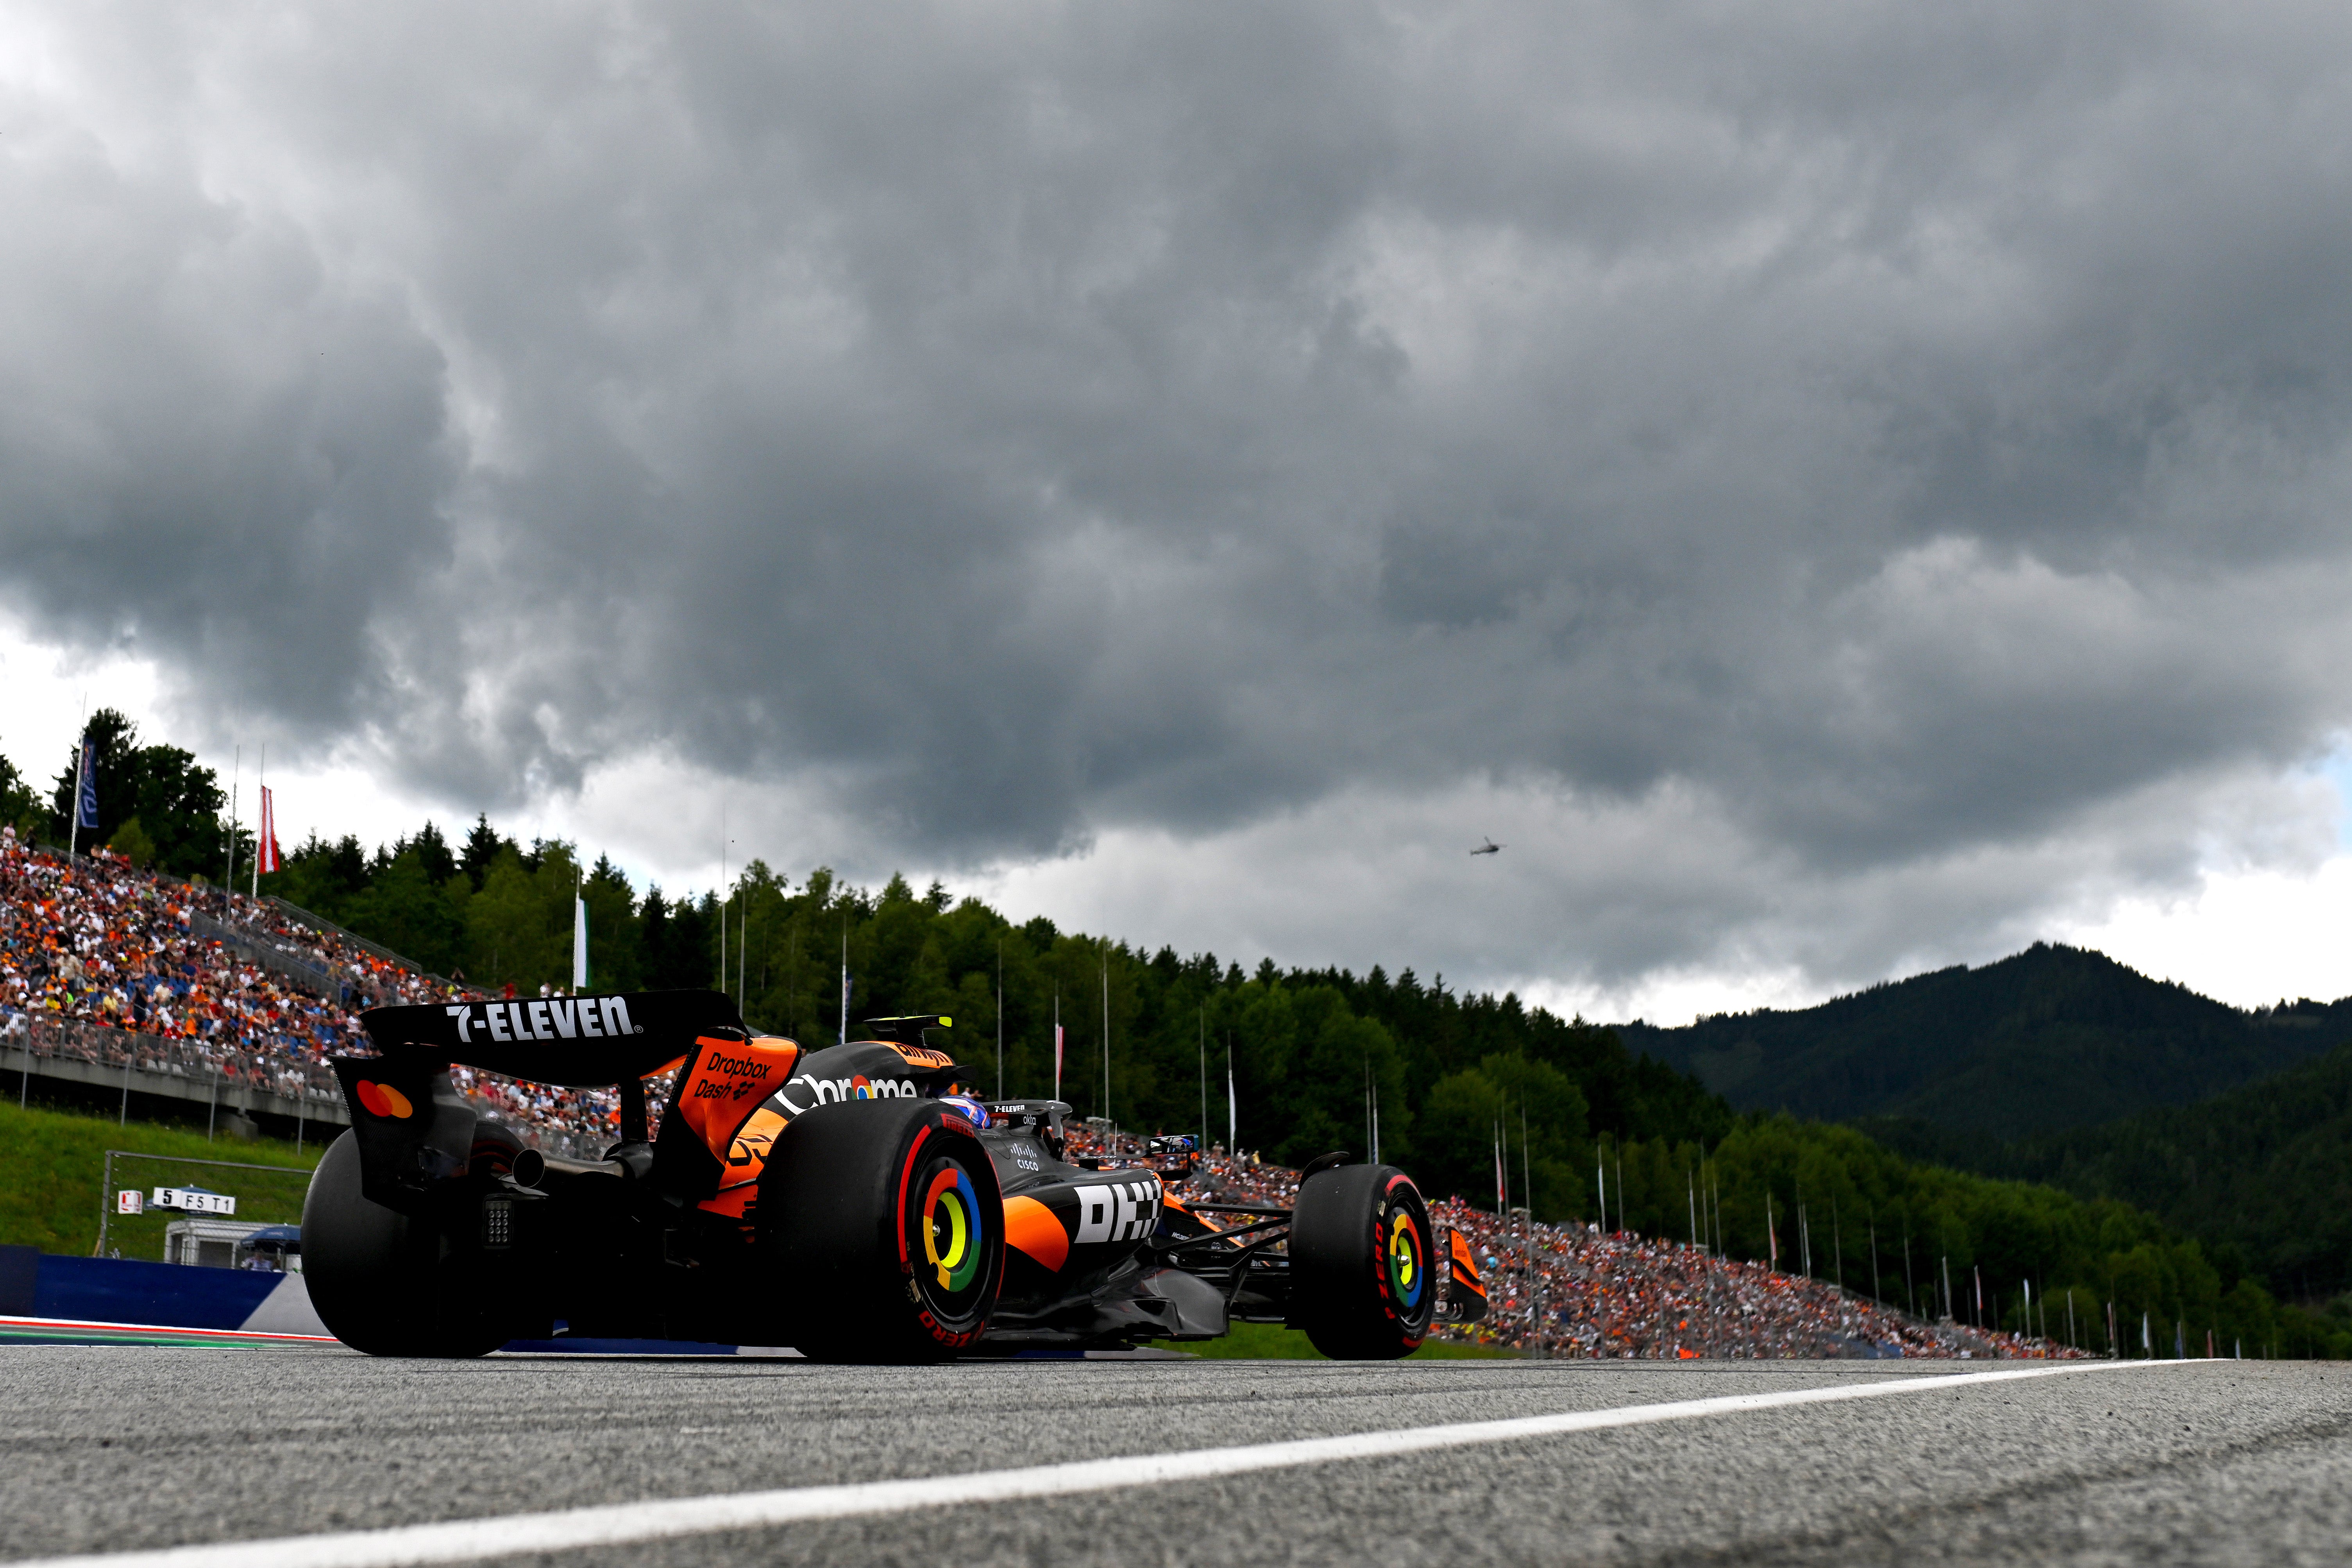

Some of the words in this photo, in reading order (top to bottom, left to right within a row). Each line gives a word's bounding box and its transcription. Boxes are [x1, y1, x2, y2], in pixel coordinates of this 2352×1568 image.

[706, 1052, 772, 1080] Dropbox
[694, 1079, 732, 1099] Dash
[774, 1073, 917, 1116] Chrome
[1023, 1114, 1036, 1125] okta
[163, 1190, 172, 1204] 5
[1375, 1222, 1389, 1299] ZERO
[918, 1310, 971, 1347] ZERO
